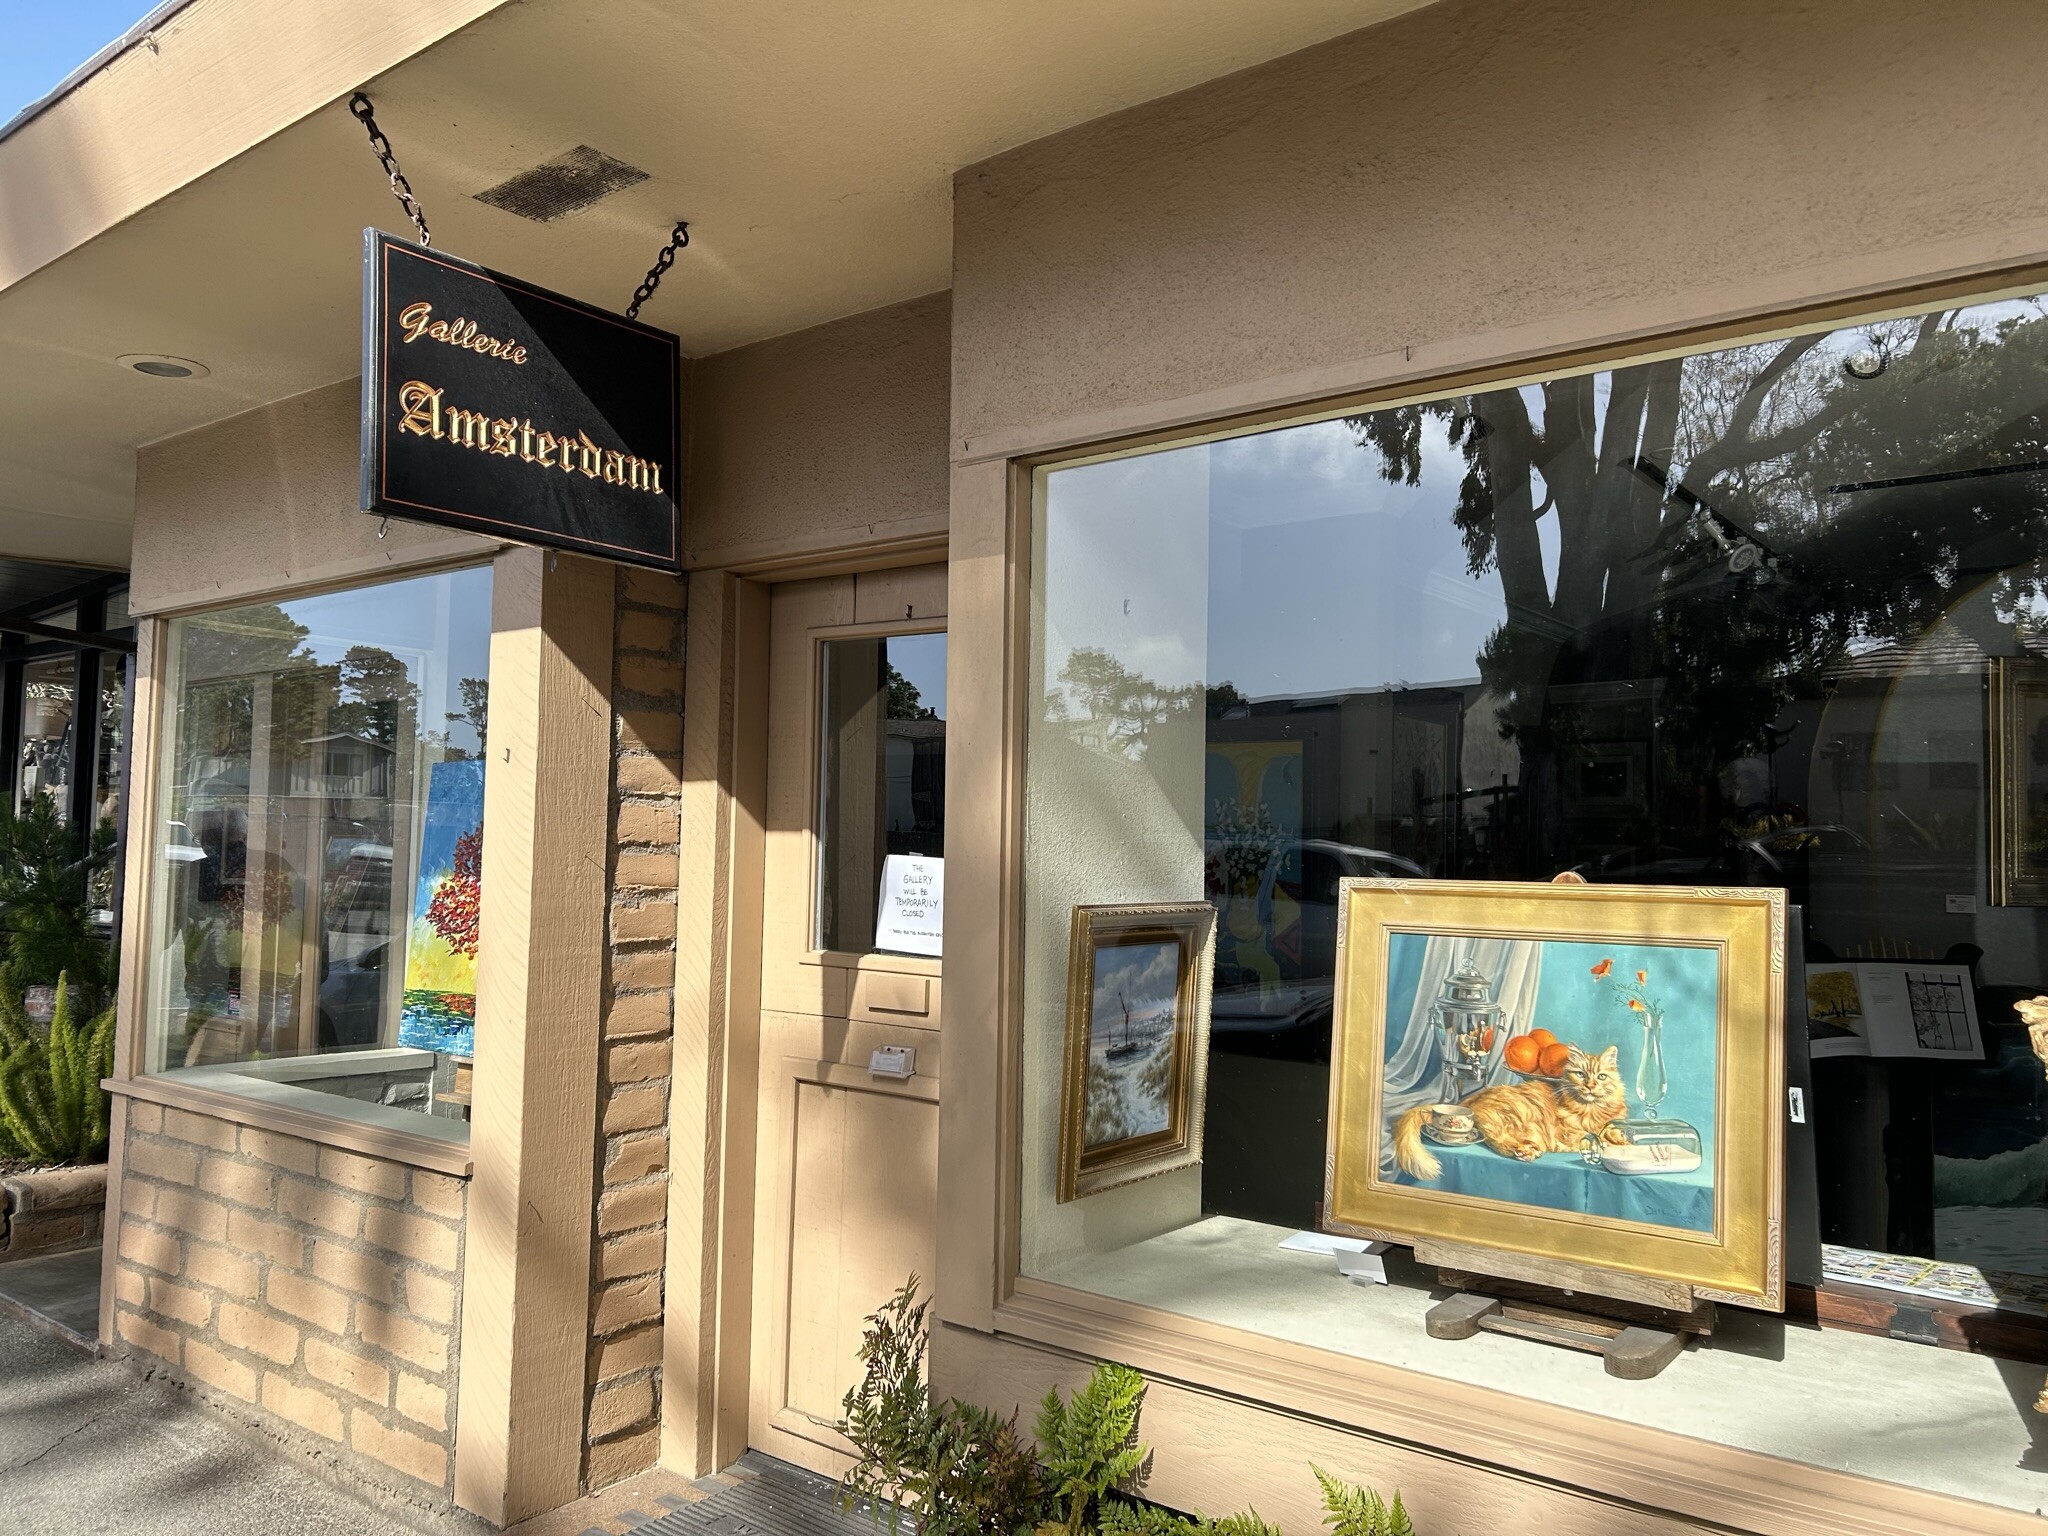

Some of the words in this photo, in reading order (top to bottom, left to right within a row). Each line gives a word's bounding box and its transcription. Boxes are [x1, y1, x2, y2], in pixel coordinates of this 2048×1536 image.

[399, 302, 528, 364] Gallerie
[398, 380, 664, 494] Amsterdam
[912, 864, 924, 873] THE
[903, 874, 933, 885] GALLERY
[903, 888, 917, 896] WILL
[920, 888, 928, 896] BE
[895, 897, 938, 909] TEMPORARILY
[901, 909, 924, 918] CLOSED
